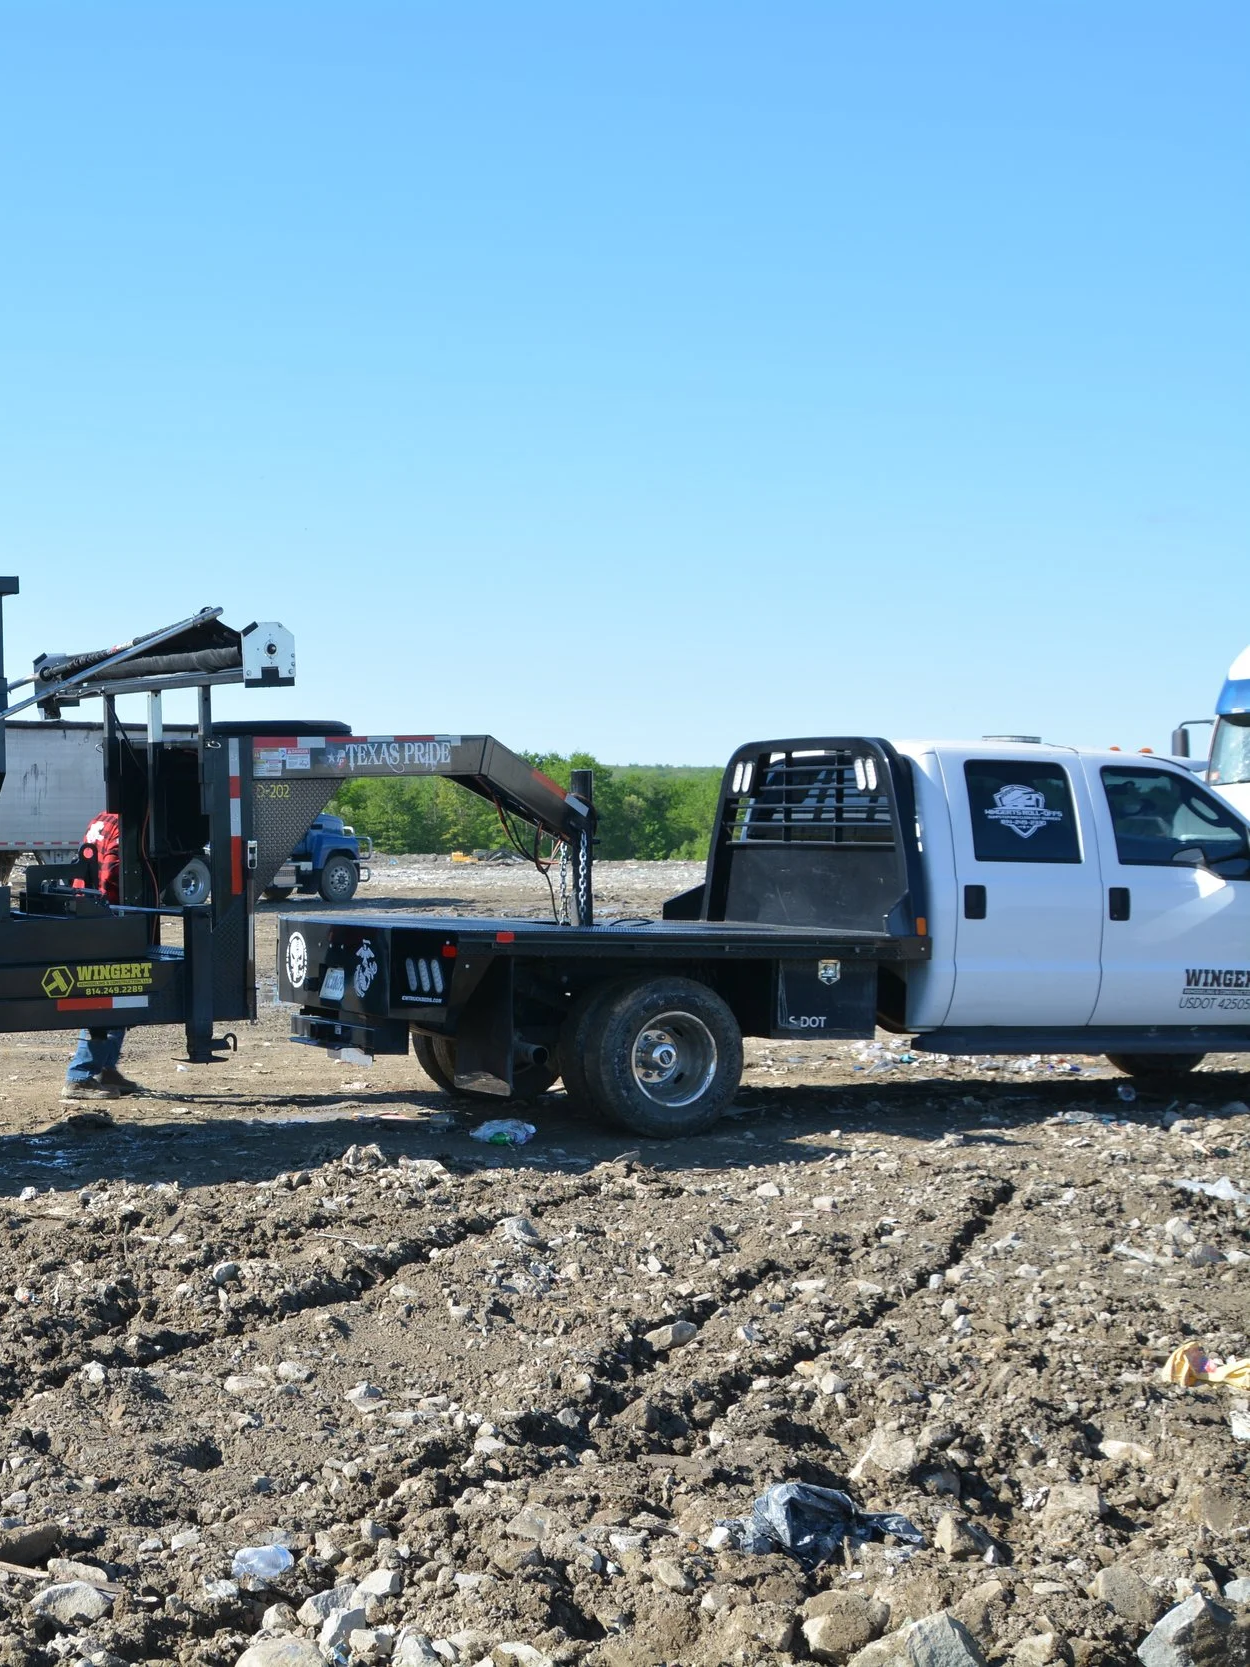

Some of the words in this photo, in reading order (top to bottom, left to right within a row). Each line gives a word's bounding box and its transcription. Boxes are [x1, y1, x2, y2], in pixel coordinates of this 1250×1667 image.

[346, 742, 405, 773] TEXAS
[404, 741, 451, 772] PRIDE
[77, 962, 152, 980] WINGERT
[85, 985, 143, 996] 814.249.2289
[1178, 996, 1218, 1009] USDOT
[800, 1016, 827, 1028] DOT
